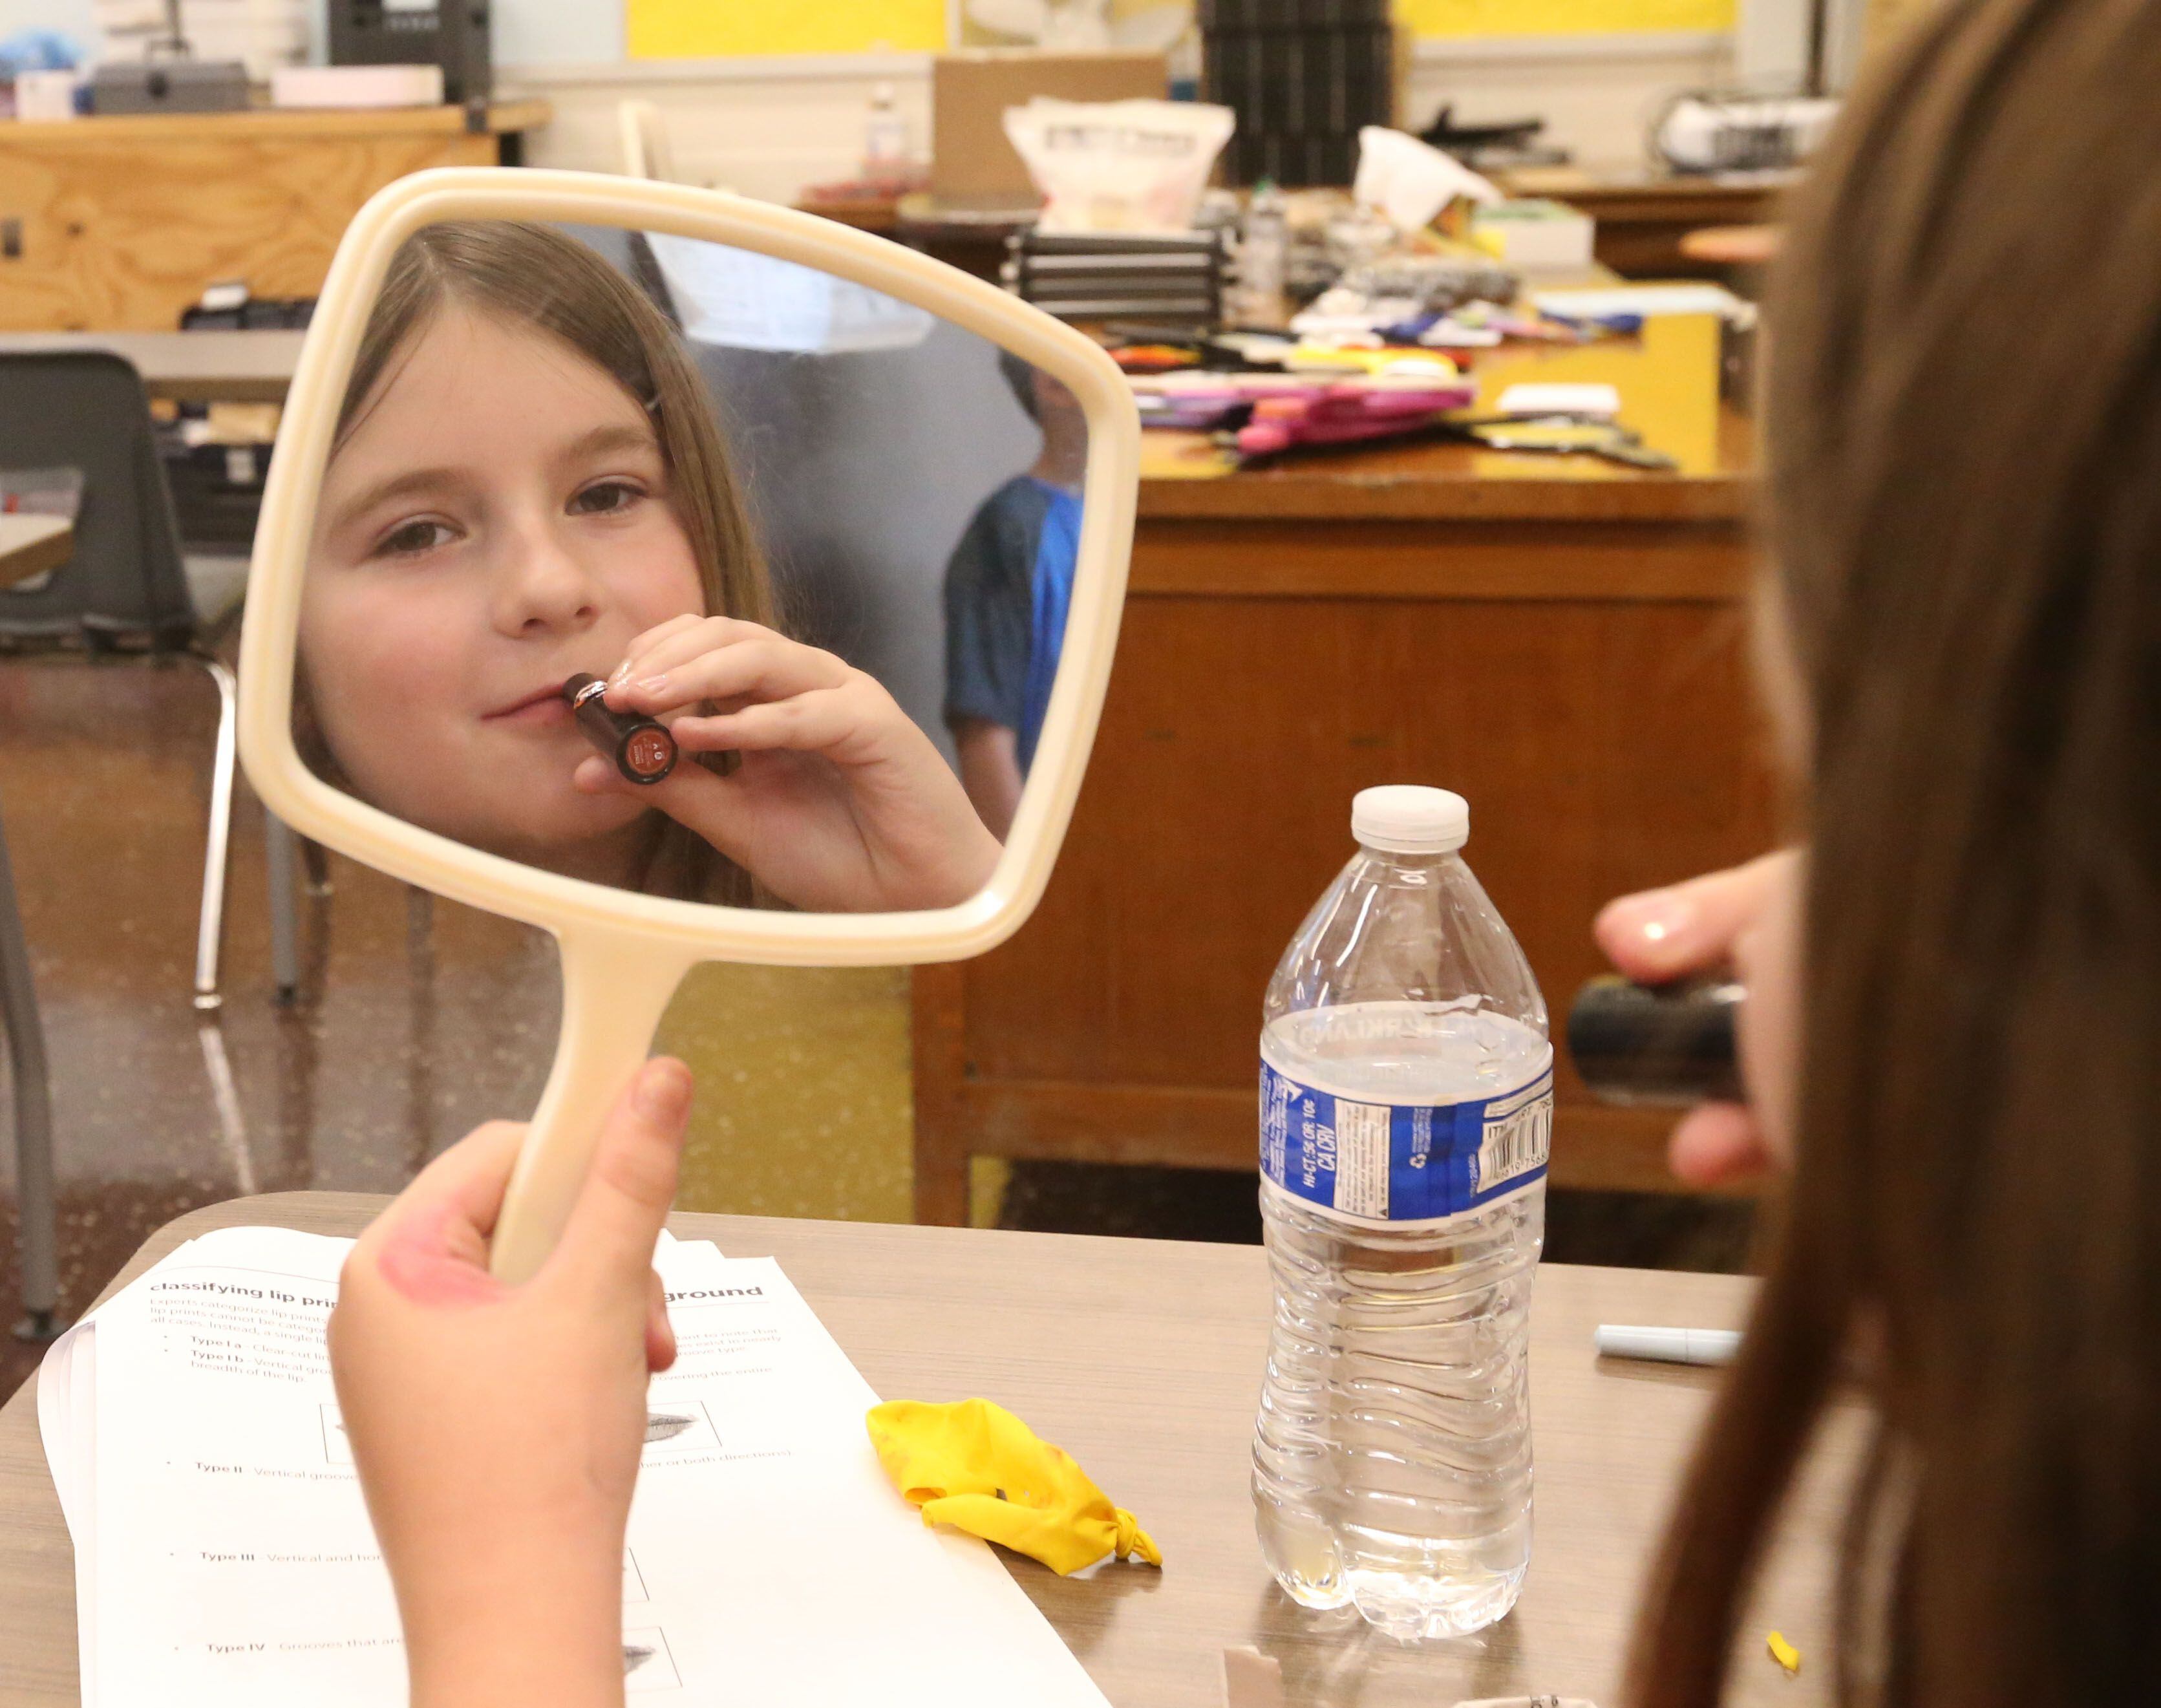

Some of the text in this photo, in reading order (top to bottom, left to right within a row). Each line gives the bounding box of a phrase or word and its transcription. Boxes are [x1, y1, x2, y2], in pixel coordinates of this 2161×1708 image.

[1316, 1123, 1336, 1172] CA CRV
[150, 1281, 262, 1299] classifying
[270, 1290, 295, 1303] lip
[150, 1297, 197, 1306] Experts
[201, 1302, 268, 1313] categorize
[272, 1308, 287, 1318] lip
[151, 1307, 166, 1315] lip
[171, 1308, 207, 1317] prints
[211, 1312, 253, 1321] cannot
[259, 1316, 275, 1325] be
[191, 1335, 223, 1346] Type
[275, 1332, 312, 1343] single
[191, 1349, 224, 1361] Type
[254, 1358, 303, 1372] Vertical
[191, 1360, 243, 1374] breadth
[263, 1371, 285, 1380] the
[195, 1462, 230, 1473] Type
[253, 1467, 306, 1479] Vertical
[200, 1552, 237, 1562] Type
[240, 1553, 255, 1561] III
[266, 1553, 322, 1563] Vertical
[325, 1554, 353, 1563] and
[207, 1644, 246, 1653] Type
[279, 1641, 343, 1650] Grooves
[346, 1638, 378, 1647] that
